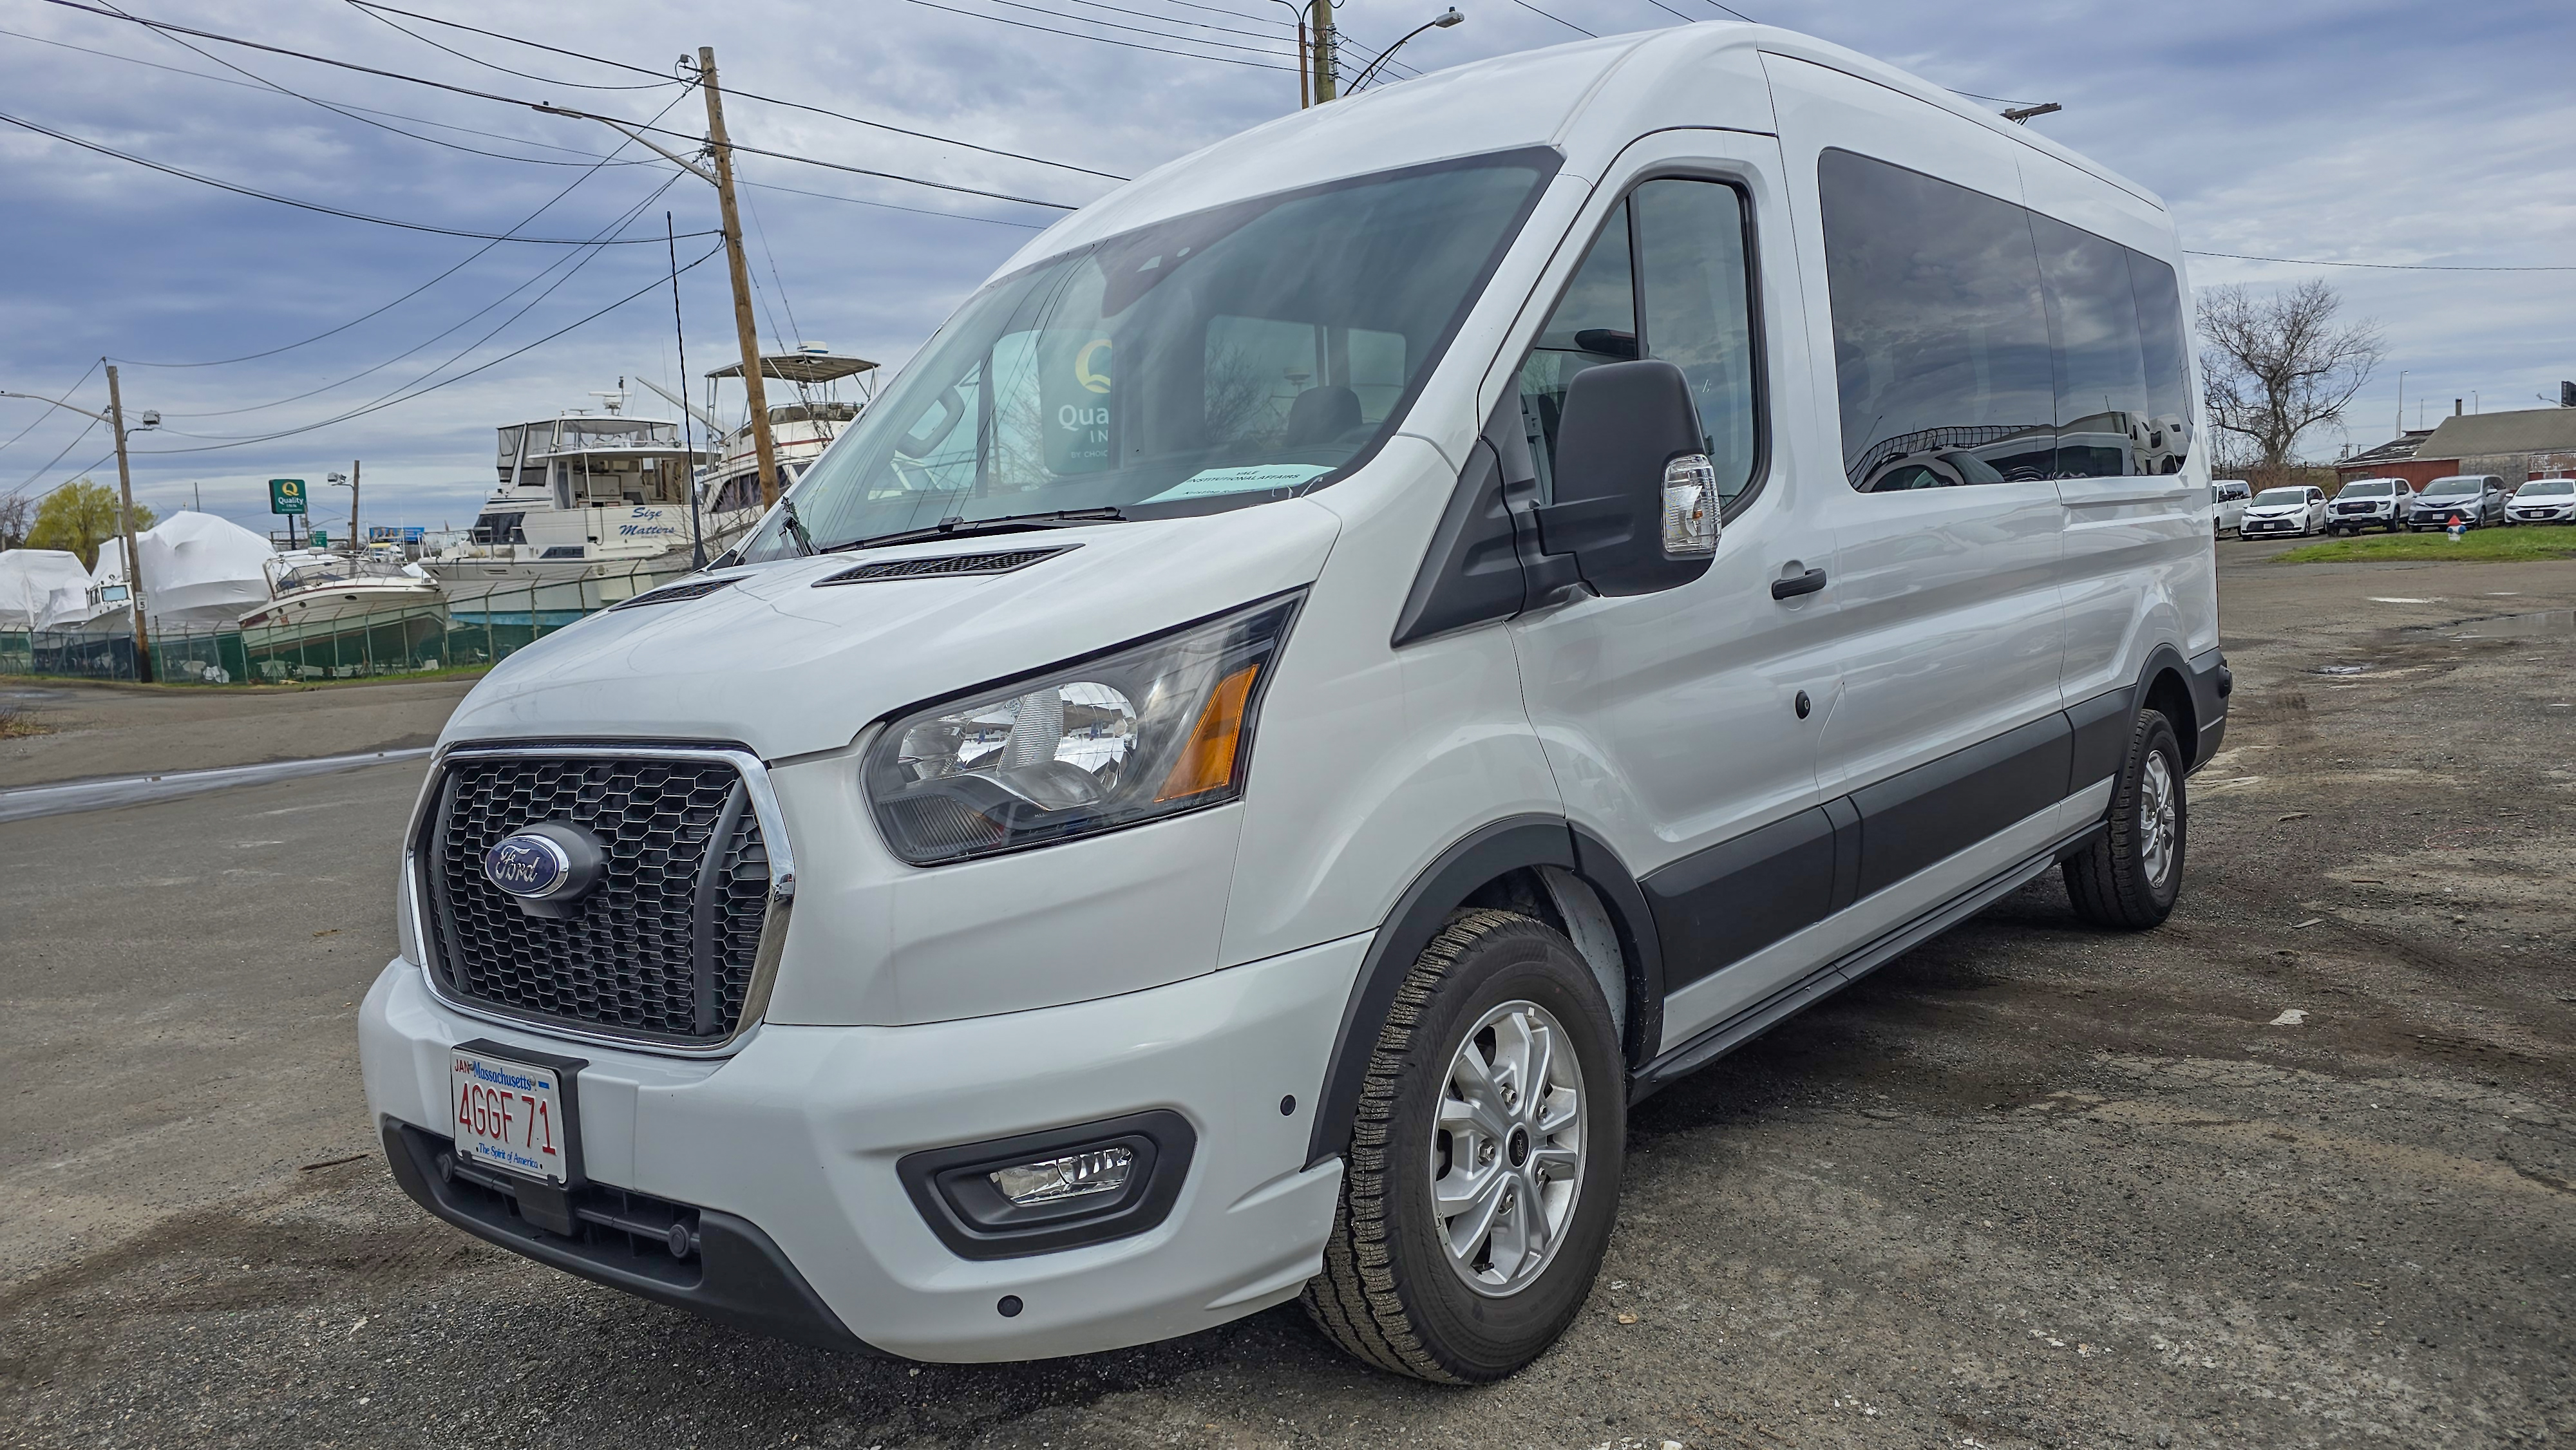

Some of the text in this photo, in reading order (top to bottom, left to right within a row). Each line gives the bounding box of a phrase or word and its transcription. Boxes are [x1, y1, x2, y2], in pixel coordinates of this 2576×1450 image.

[278, 496, 303, 505] Quality
[631, 507, 663, 521] Size
[619, 525, 674, 536] Matters
[140, 601, 146, 609] 5
[495, 845, 540, 883] Ford
[455, 1059, 532, 1091] JAN Massachusetts
[459, 1082, 556, 1156] 4GGF 71
[478, 1142, 538, 1169] The Spirit of America
